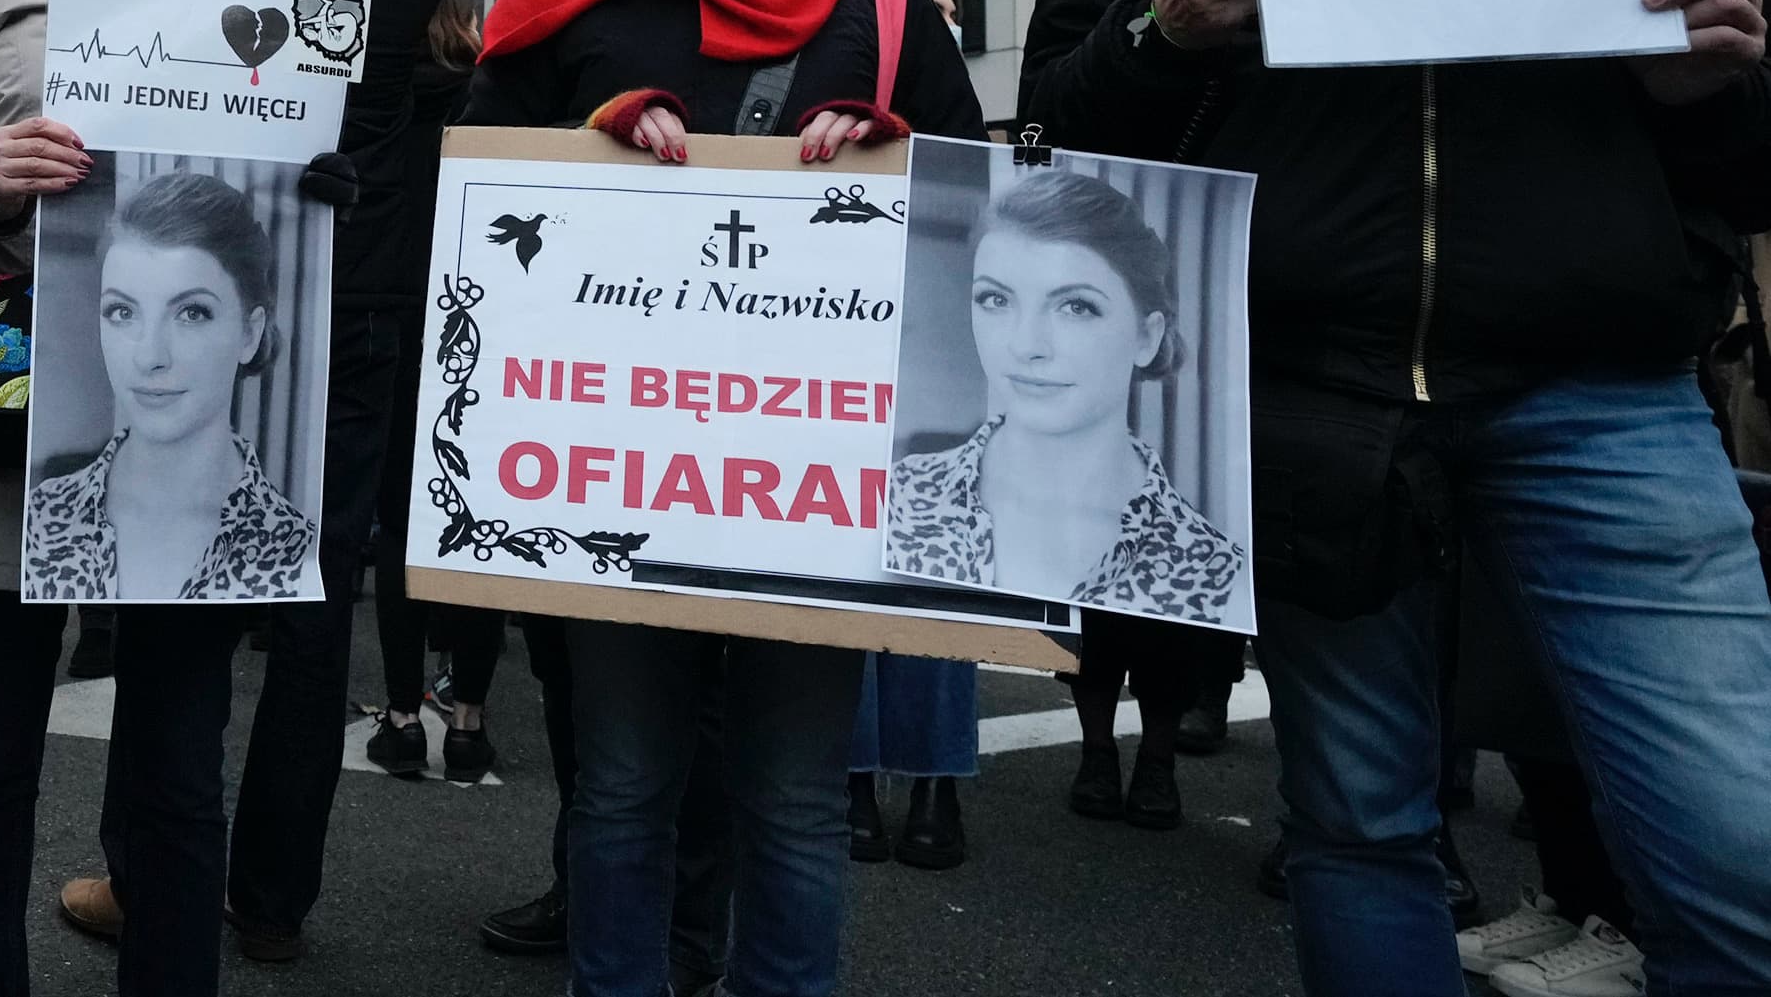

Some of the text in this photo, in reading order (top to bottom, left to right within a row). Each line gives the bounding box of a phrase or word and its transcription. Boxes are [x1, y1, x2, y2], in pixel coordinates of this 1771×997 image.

[296, 62, 353, 79] ABSURDU
[124, 84, 208, 112] JEDNEJ
[224, 93, 307, 122] WIĘCEJ
[571, 272, 895, 324] Imię i Nazwisko
[502, 356, 607, 404] NIE
